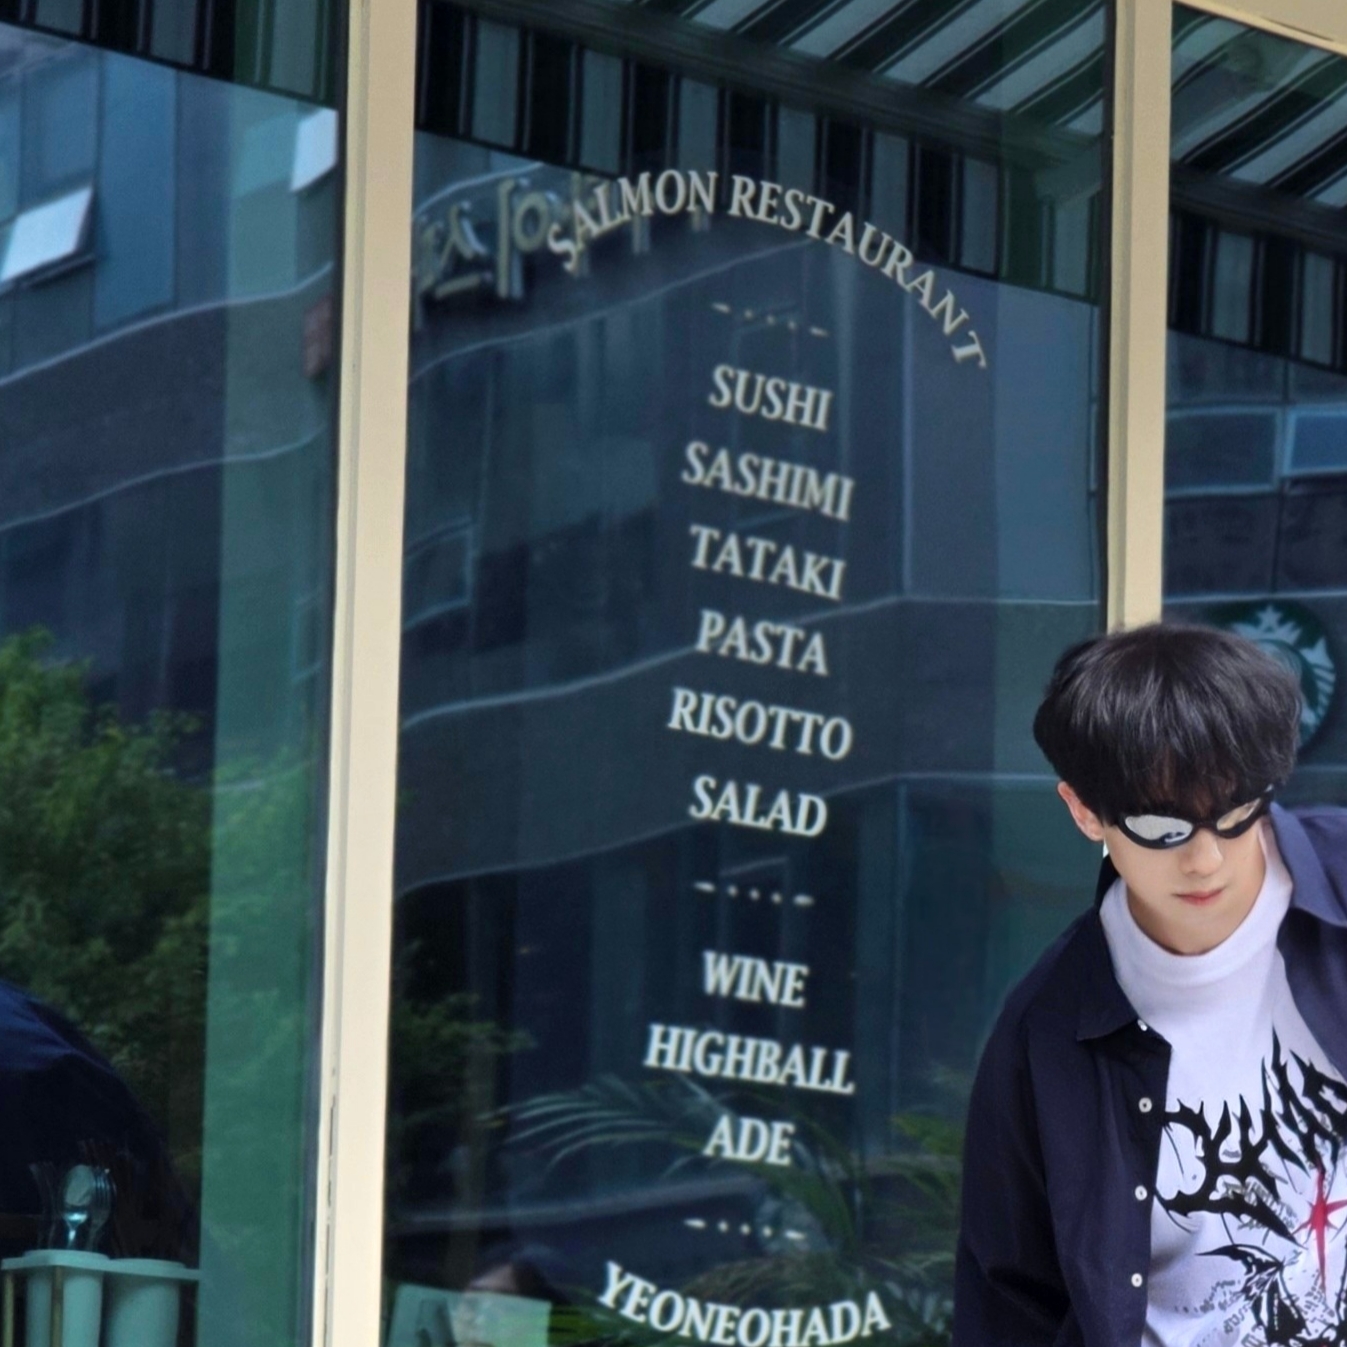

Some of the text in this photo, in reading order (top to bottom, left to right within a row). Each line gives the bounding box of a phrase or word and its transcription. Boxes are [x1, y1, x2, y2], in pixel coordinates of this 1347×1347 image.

[547, 168, 718, 274] SALMON
[727, 175, 987, 371] RESTAURANT
[709, 365, 832, 431] SUSHI
[682, 441, 854, 521] SASHIMI
[690, 525, 845, 601] TATAKI
[695, 610, 828, 676] PASTA
[667, 687, 852, 760] RISOTTO
[689, 775, 828, 838] SALAD
[703, 951, 809, 1008] WINE
[644, 1024, 855, 1095] HIGHBALL
[703, 1114, 795, 1167] ADE
